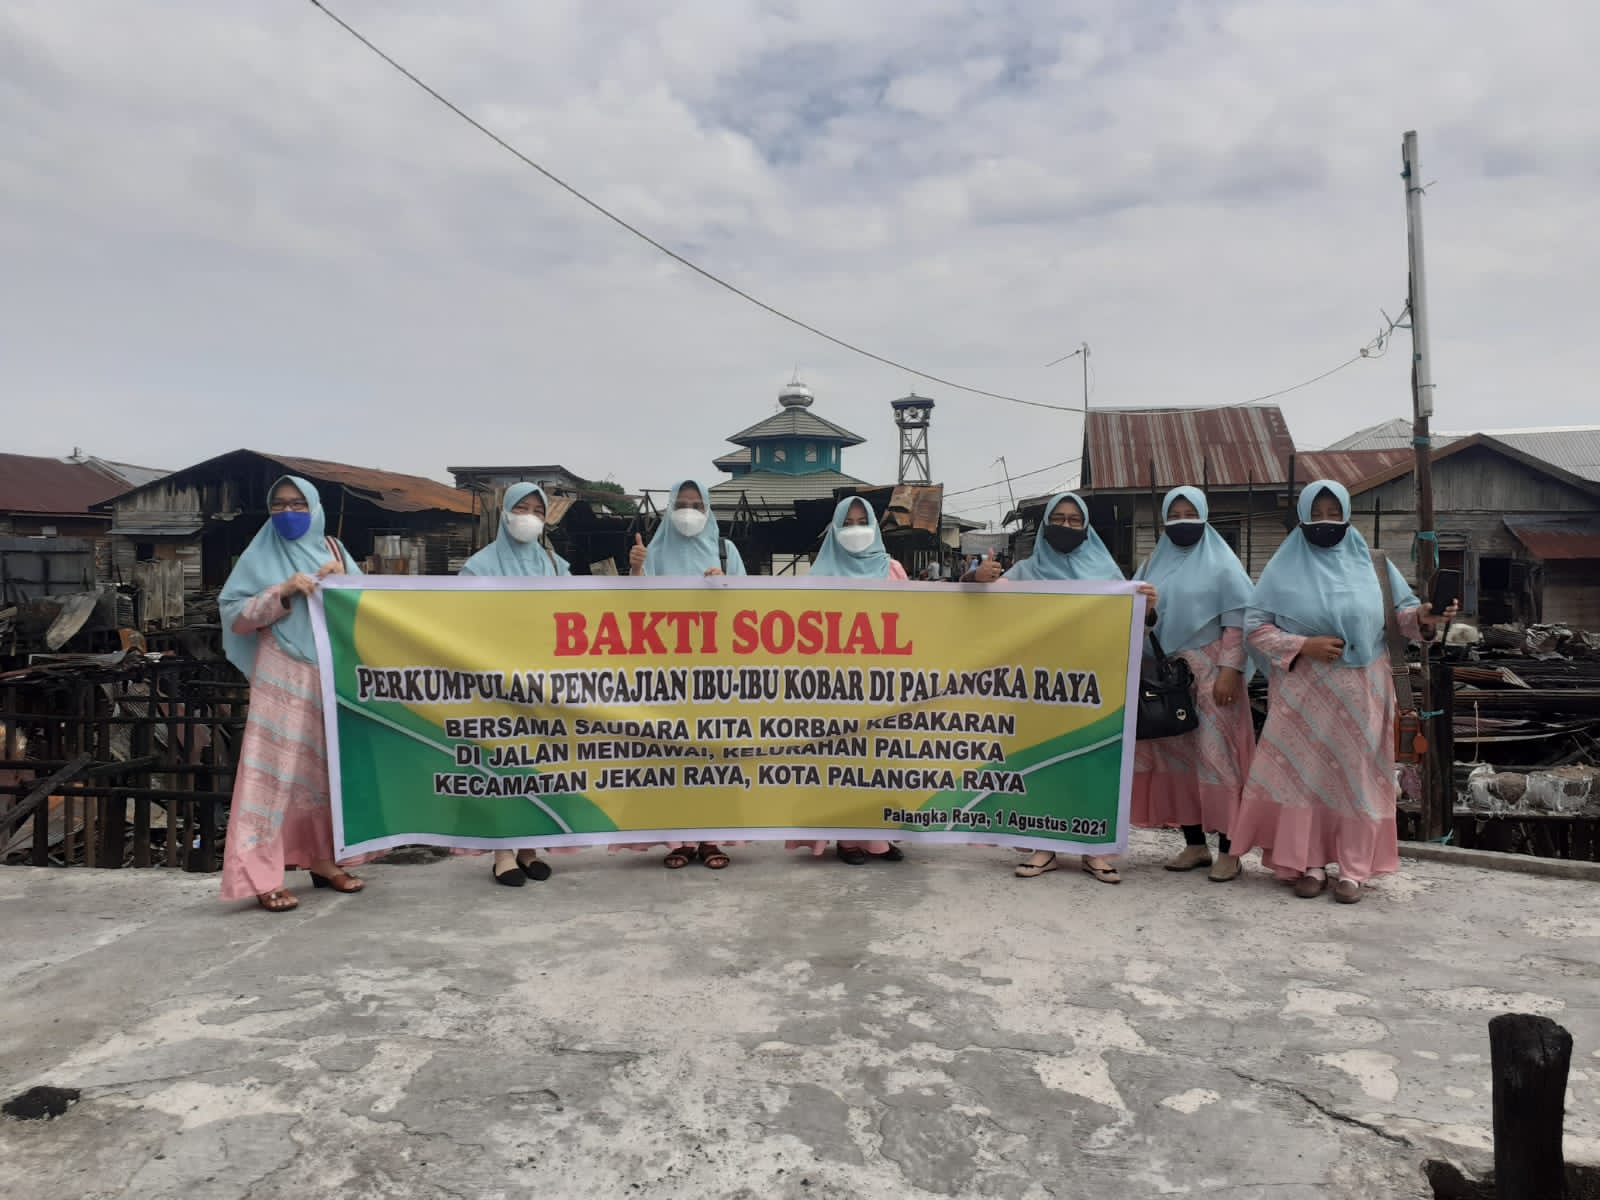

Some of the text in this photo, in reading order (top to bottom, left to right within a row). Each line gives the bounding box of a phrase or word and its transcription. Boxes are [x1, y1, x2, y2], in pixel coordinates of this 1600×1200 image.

[553, 610, 913, 656] BAKTI SOSIAL
[357, 667, 1101, 704] PERKUMPULAN PENGAJIAN IBU-IBU KOBAR DI PALANGKA RAYA
[446, 711, 1015, 740] BERSAMA SAUDARA KITA KORBAN KEBAKARAN
[456, 745, 481, 765] DI
[489, 743, 569, 766] JALAN
[875, 738, 1004, 762] PALANGKA
[435, 765, 1025, 796] KECAMATAN JEKAN RAYA, KOTA PALANGKA RAYA
[884, 807, 1108, 835] Palangka Raya, 1 Agustus 2021
